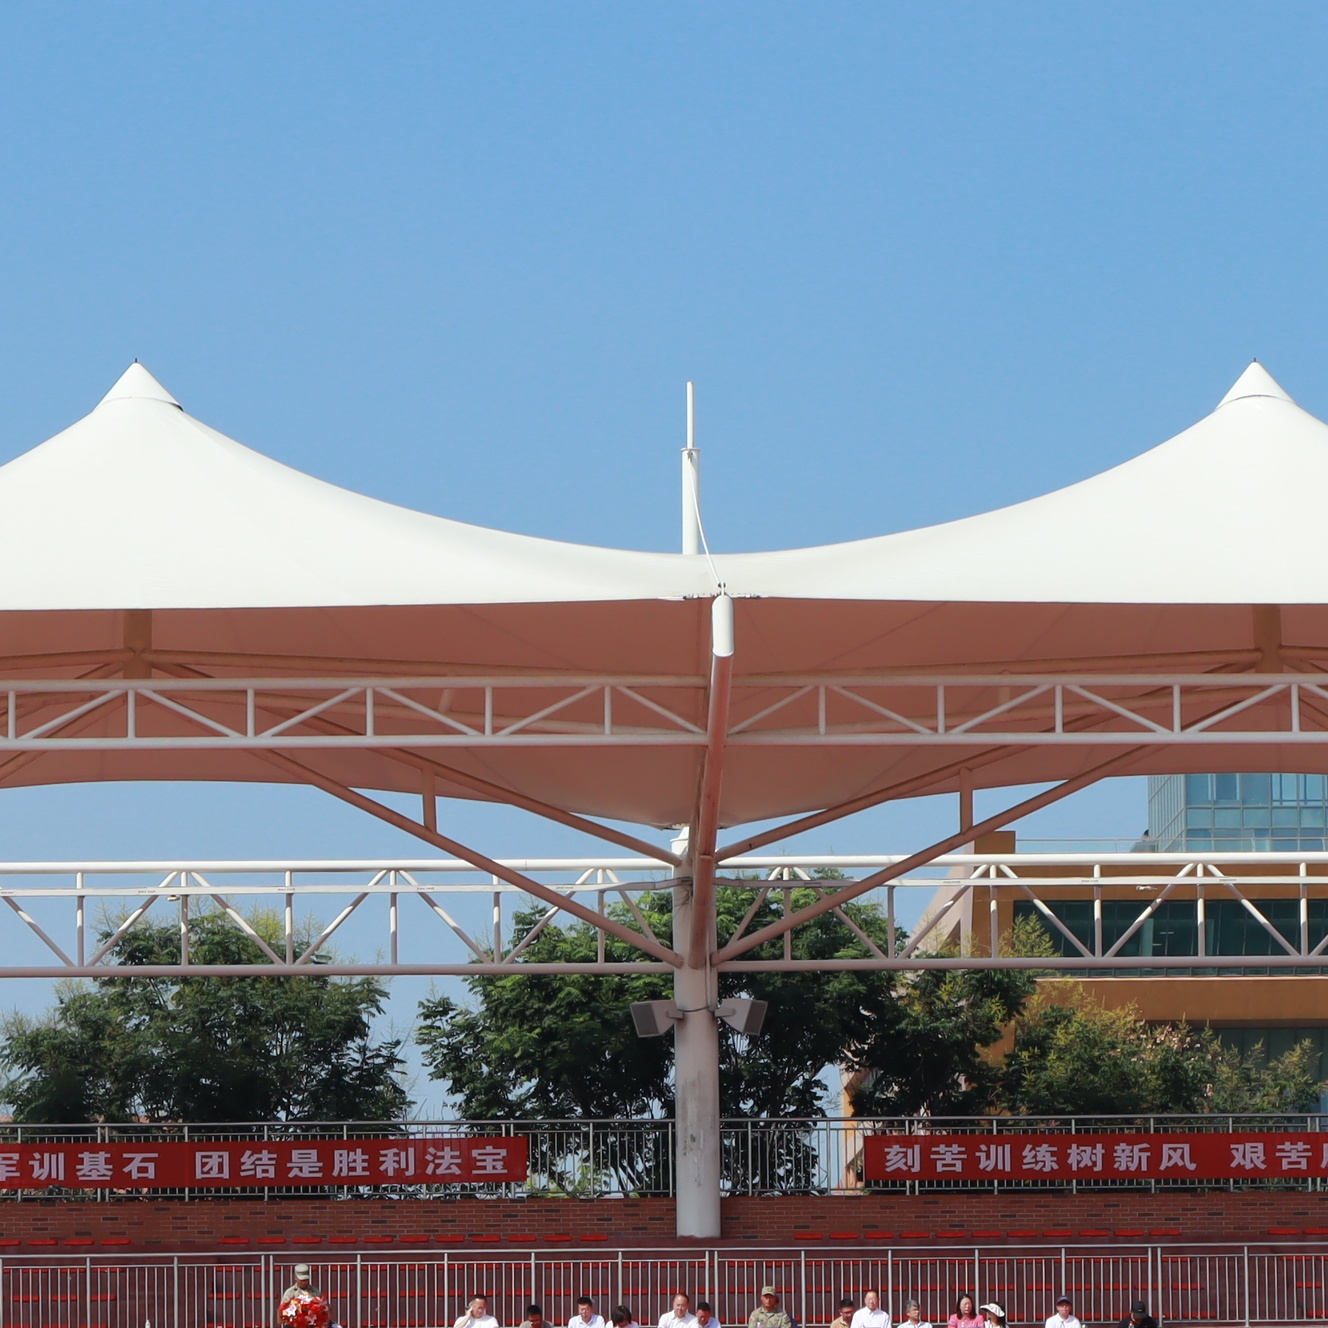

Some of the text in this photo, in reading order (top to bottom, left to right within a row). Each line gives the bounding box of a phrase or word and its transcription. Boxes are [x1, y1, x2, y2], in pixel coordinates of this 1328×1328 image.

[194, 1145, 509, 1180] 团结是胜利法宝
[884, 1142, 1197, 1173] 刻苦训练树新风
